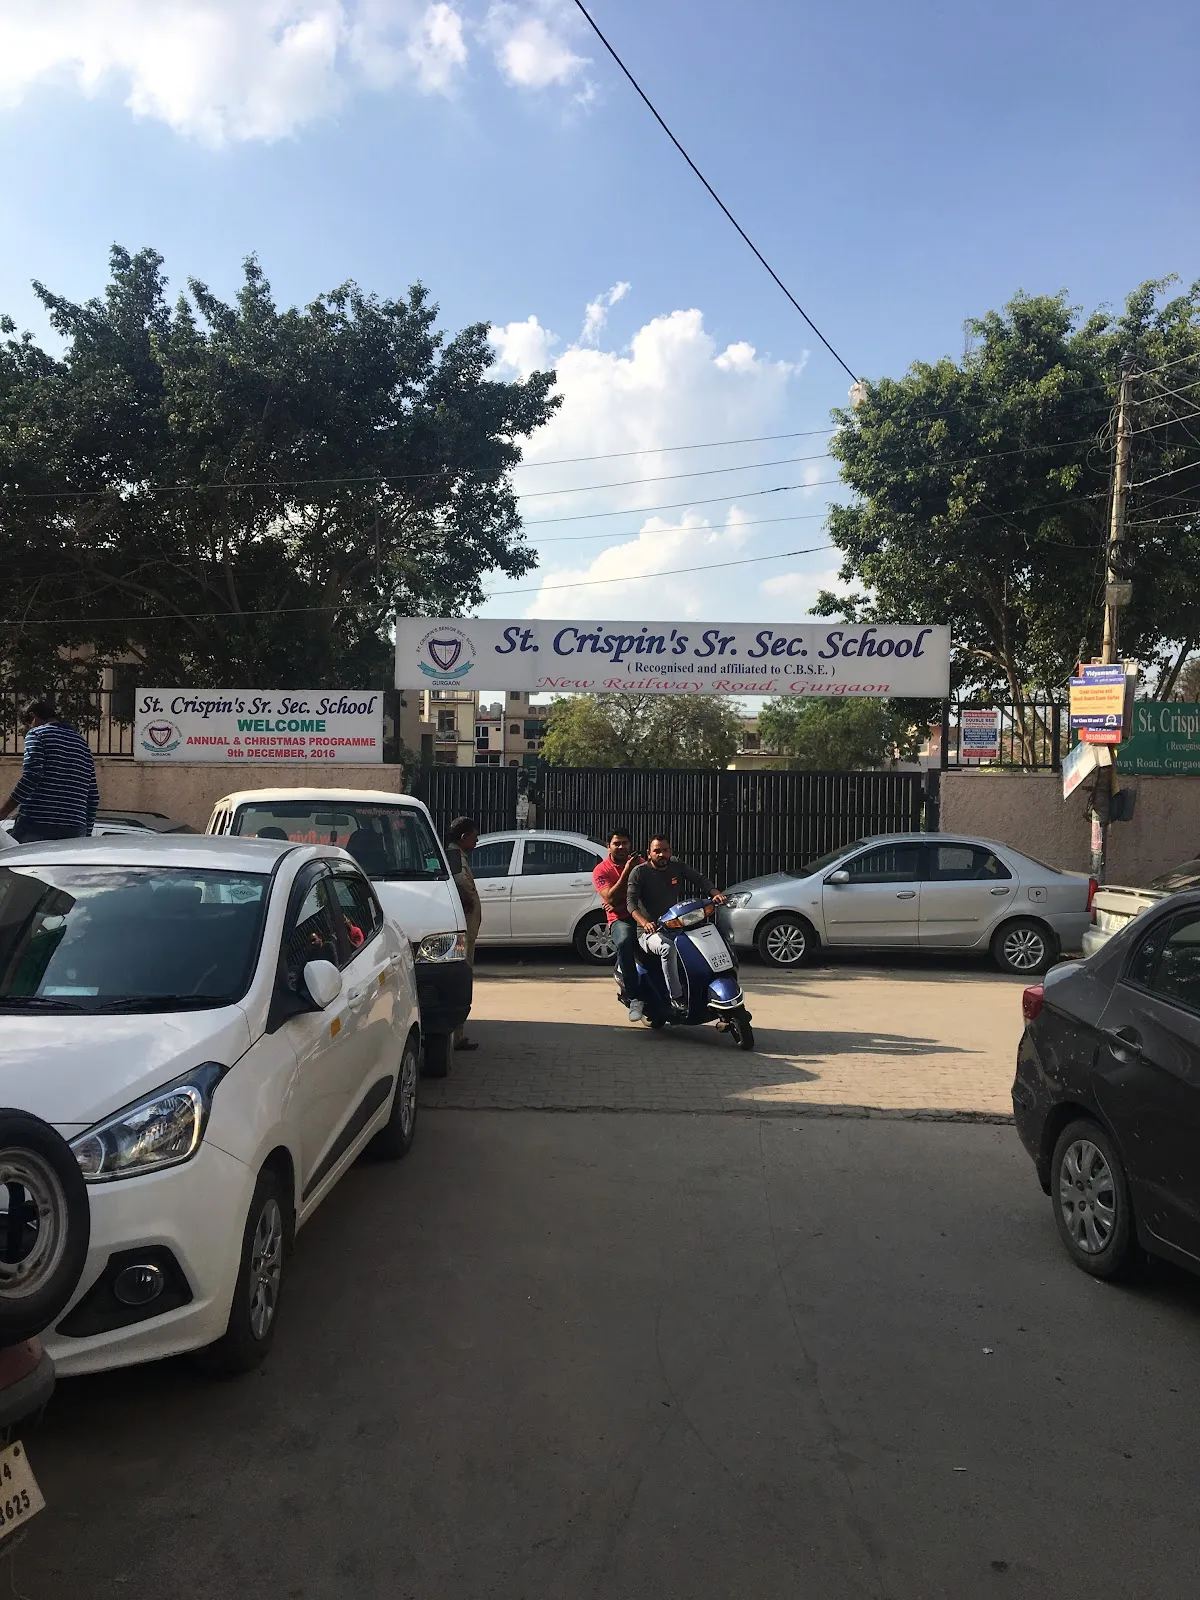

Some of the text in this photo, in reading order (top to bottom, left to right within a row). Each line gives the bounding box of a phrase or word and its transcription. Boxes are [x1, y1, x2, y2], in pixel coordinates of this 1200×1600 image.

[495, 626, 932, 662] St. Crispin's Sr. Sec. School
[634, 661, 694, 677] Recognised
[697, 662, 718, 675] and
[720, 662, 768, 675] affiliated
[770, 664, 781, 676] to
[783, 663, 828, 676] C.B.S.E.
[535, 677, 891, 695] New Railway Road, Gurgaon
[139, 696, 377, 718] St. Crispin's Sr. Sec. School
[237, 719, 326, 732] WELCOME
[1138, 707, 1156, 733] St.
[186, 736, 376, 747] ANNUAL & CHRISTMAS PROGRAMME
[227, 749, 336, 759] 9th DECEMBER, 2016
